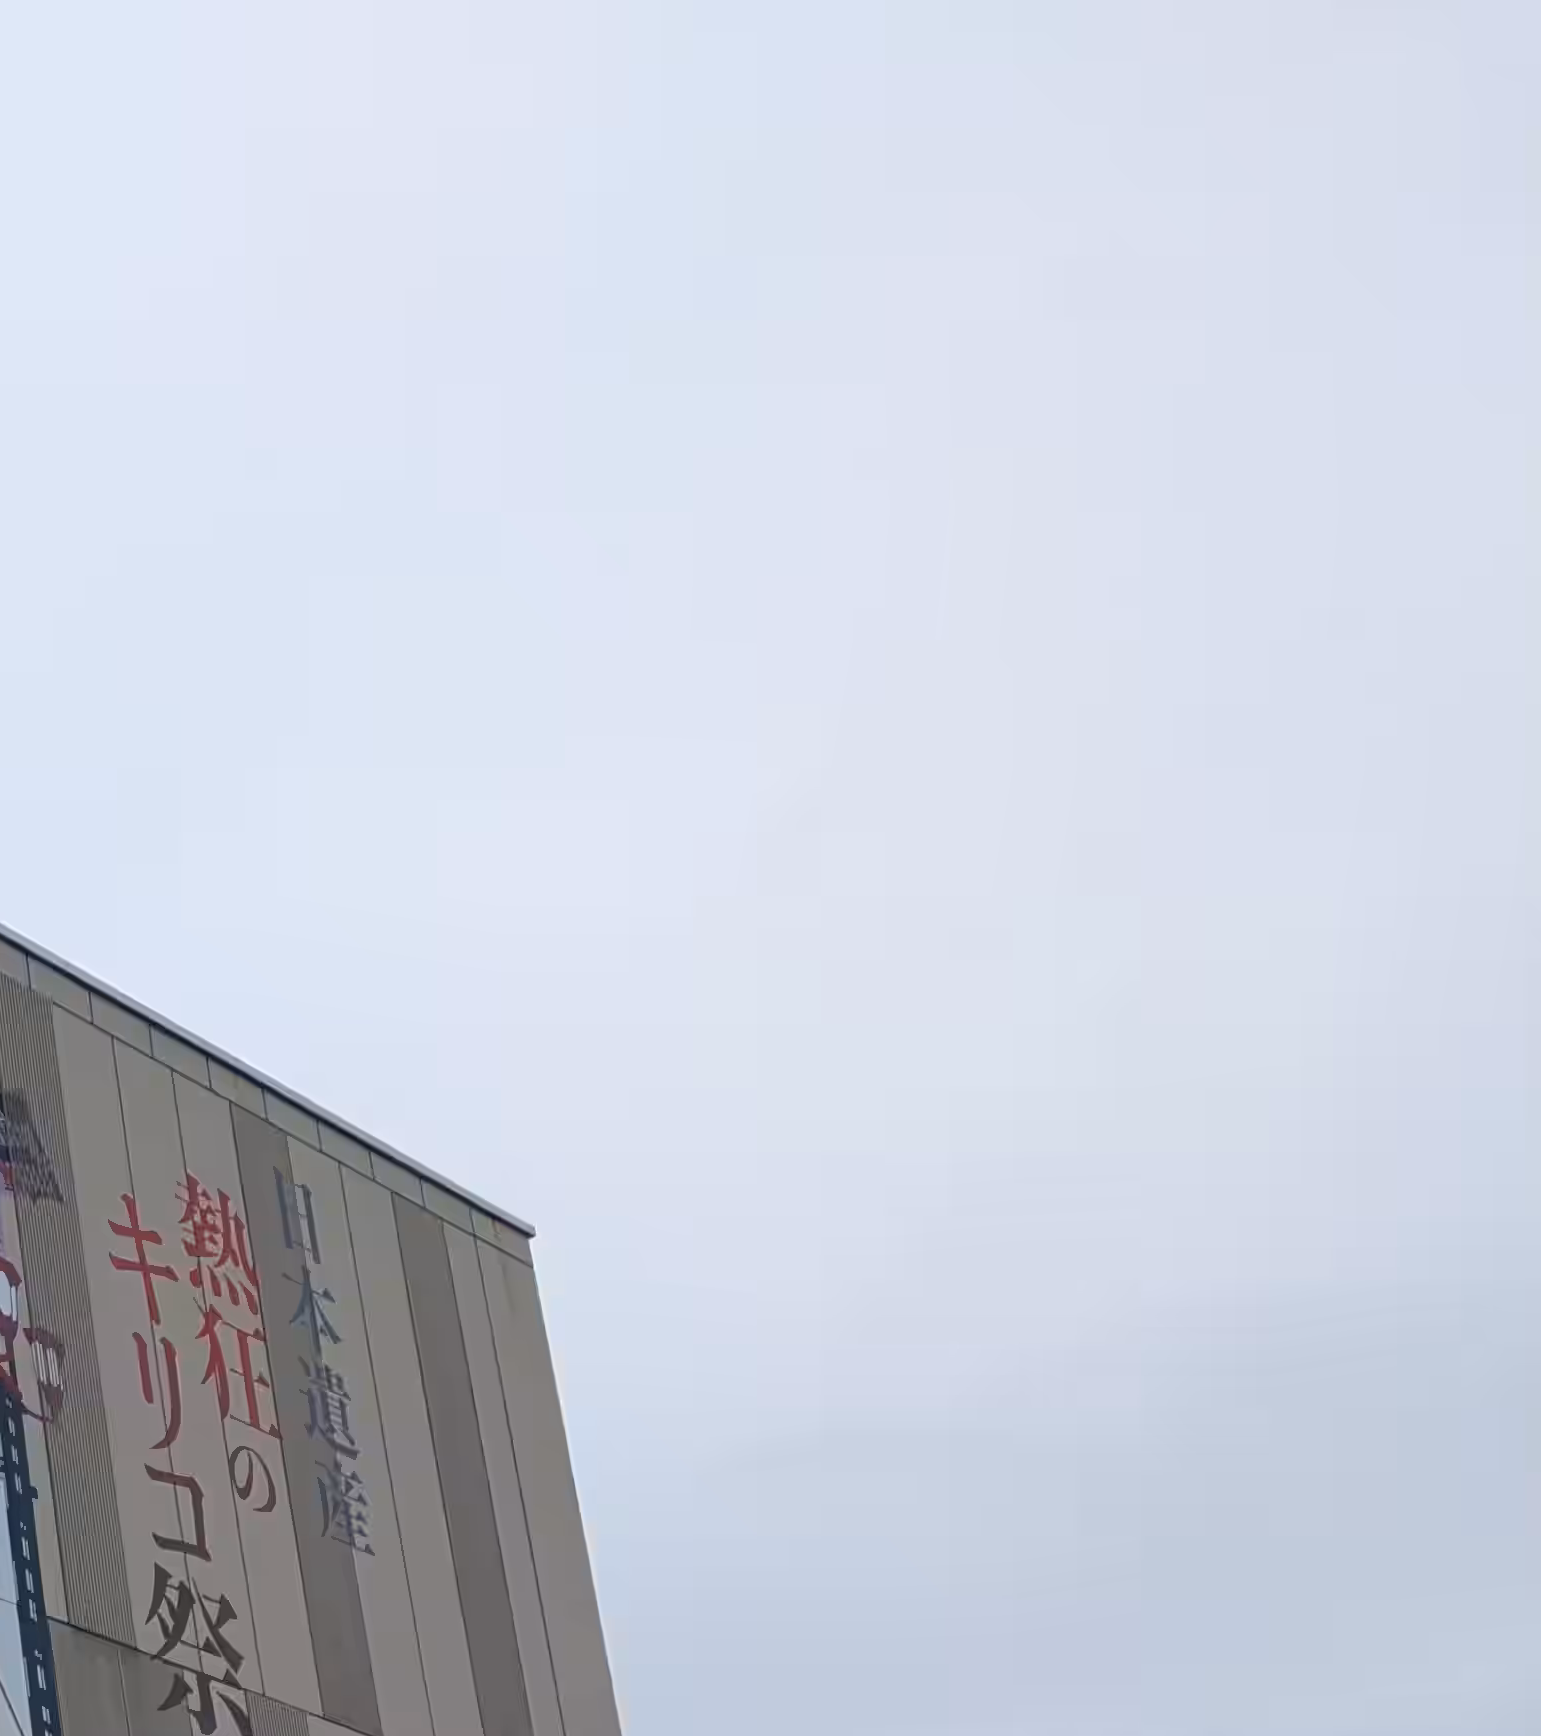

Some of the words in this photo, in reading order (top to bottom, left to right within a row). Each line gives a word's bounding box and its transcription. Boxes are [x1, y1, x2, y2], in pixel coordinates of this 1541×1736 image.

[174, 1168, 283, 1514] 熱狂の
[272, 1165, 375, 1557] 日本遺産
